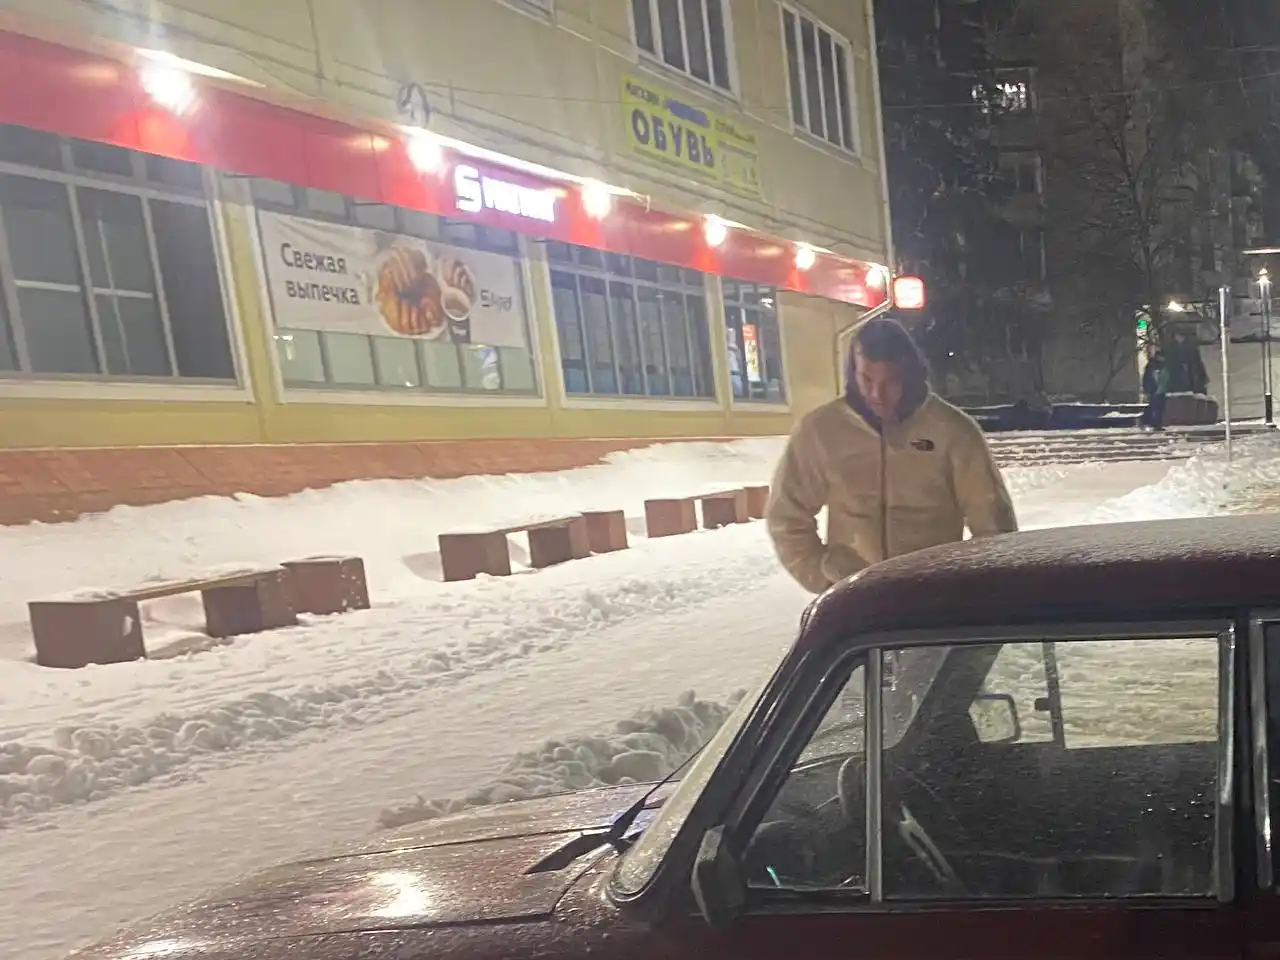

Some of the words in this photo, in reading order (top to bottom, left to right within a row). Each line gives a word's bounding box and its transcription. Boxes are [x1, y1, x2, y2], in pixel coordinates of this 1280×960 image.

[631, 108, 715, 169] ОБУВЬ
[280, 242, 348, 274] Свежая
[285, 280, 362, 306] выпечка
